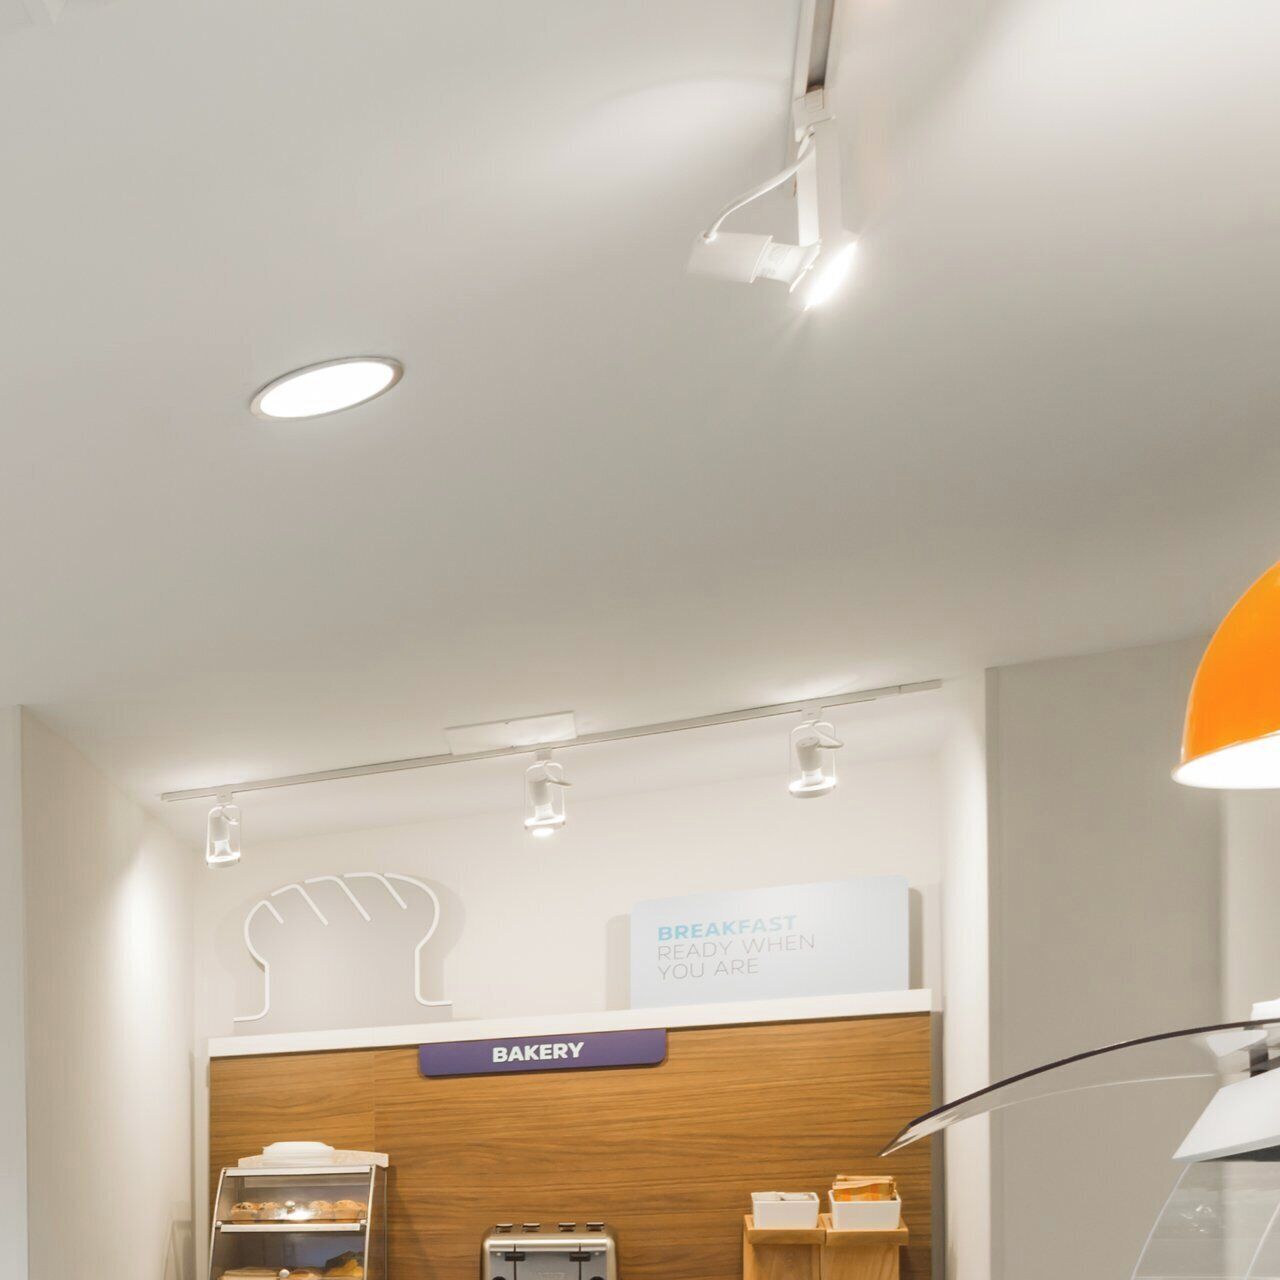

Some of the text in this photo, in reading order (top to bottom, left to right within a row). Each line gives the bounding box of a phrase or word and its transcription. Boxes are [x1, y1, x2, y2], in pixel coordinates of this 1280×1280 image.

[657, 914, 798, 942] BREAKFAST
[657, 934, 816, 961] READY WHEN
[657, 957, 760, 981] YOU ARE
[492, 1041, 585, 1063] BAKERY
